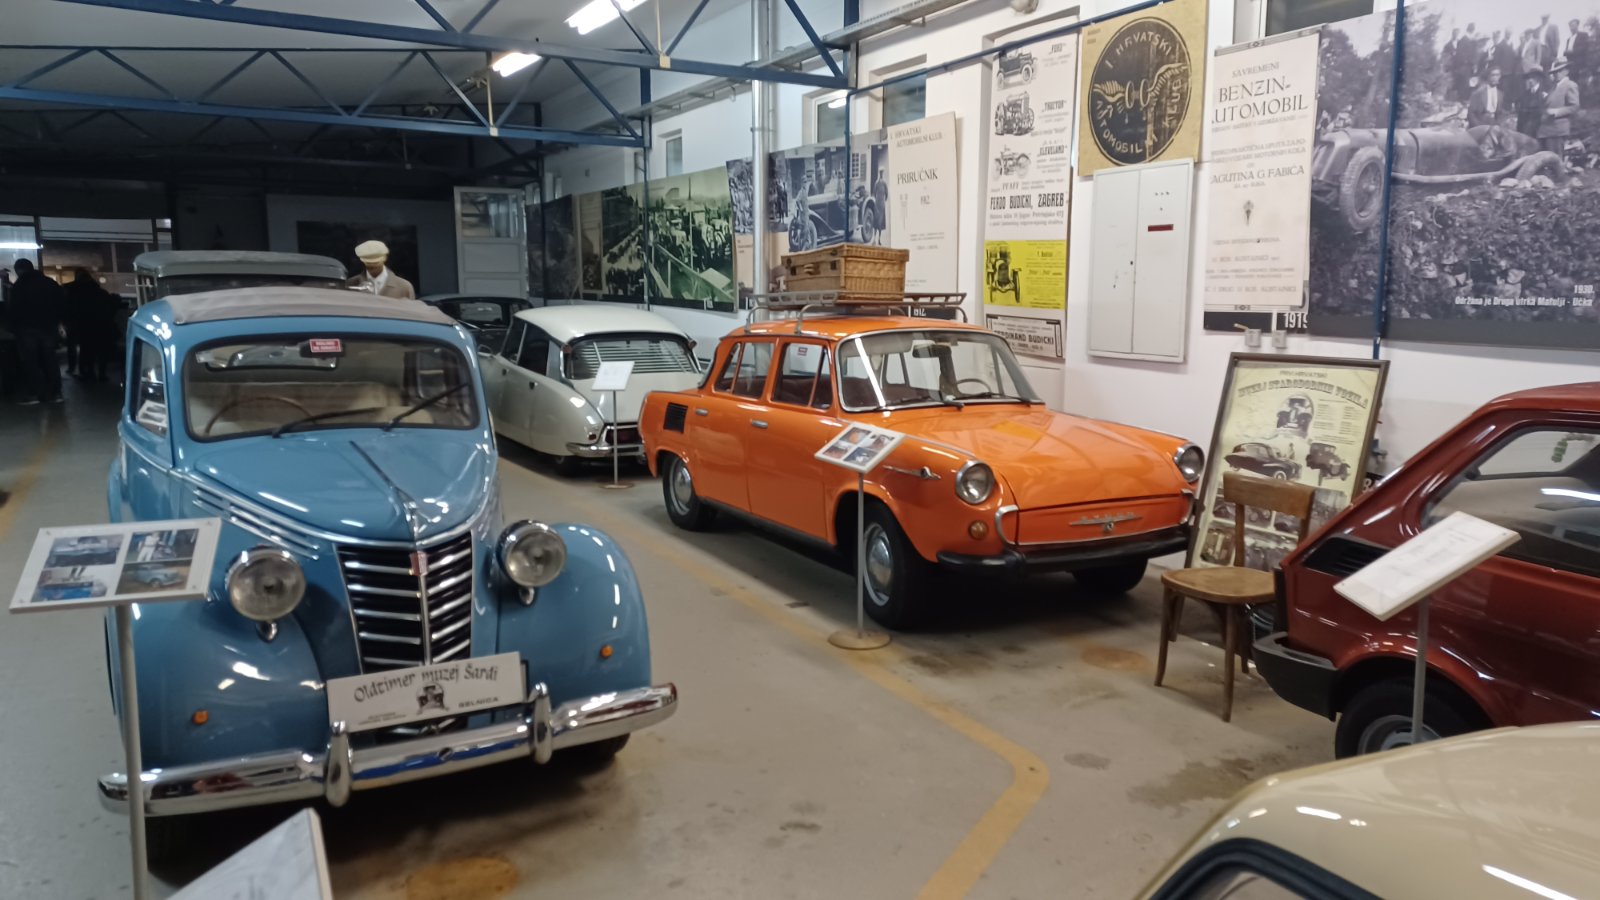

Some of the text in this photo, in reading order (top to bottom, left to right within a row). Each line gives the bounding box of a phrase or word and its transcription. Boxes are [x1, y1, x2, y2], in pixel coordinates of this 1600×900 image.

[1115, 31, 1172, 56] HRVATSKI
[1232, 62, 1280, 79] SAVREMENI
[1161, 78, 1182, 129] KLUB
[1212, 94, 1308, 124] UTOMOBIL
[1038, 192, 1064, 208] ZAGREB
[1455, 296, 1483, 305] Održana
[1484, 296, 1492, 307] je
[1493, 296, 1514, 307] Druga
[1537, 297, 1566, 307] Matulji
[1572, 297, 1593, 307] Učka
[353, 672, 416, 703] Oldtimer
[421, 664, 460, 684] muzej
